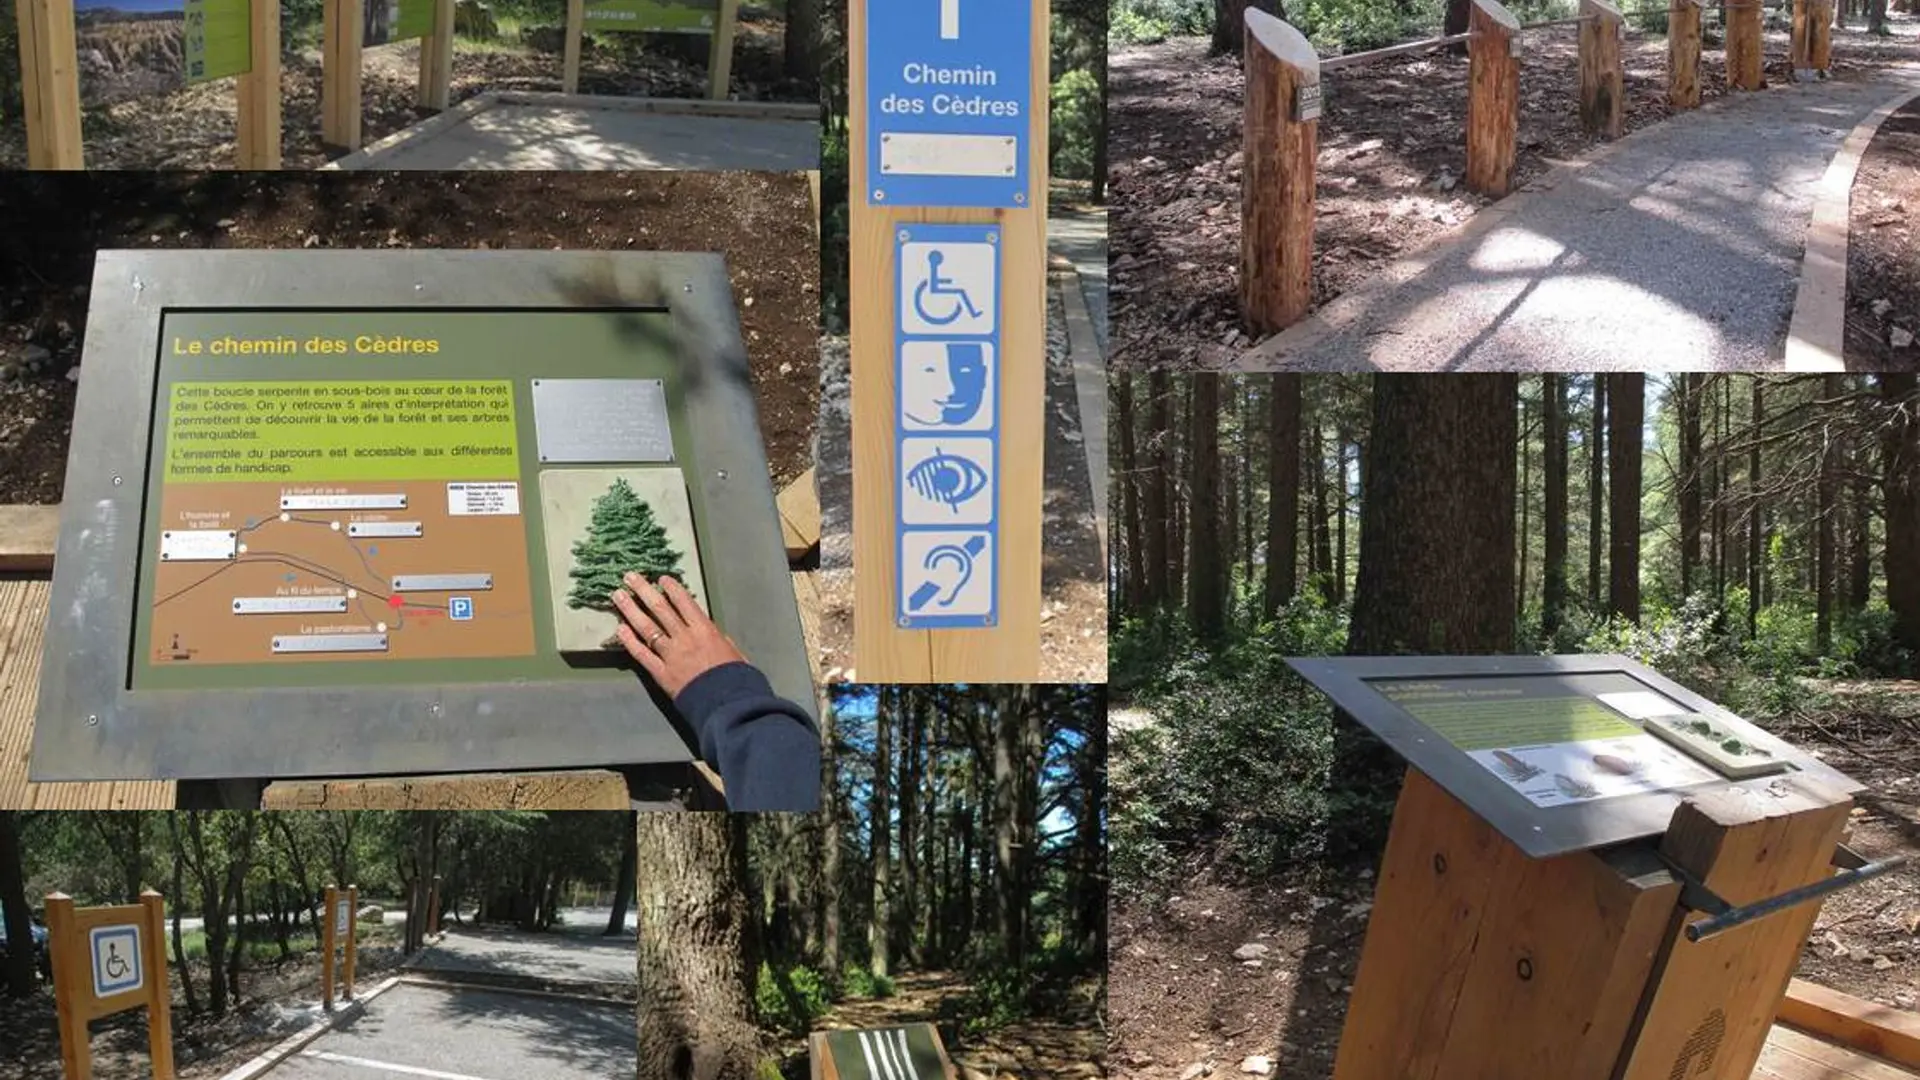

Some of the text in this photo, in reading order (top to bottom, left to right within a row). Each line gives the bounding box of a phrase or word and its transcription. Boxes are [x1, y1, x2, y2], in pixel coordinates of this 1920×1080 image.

[903, 63, 996, 86] Chemin
[880, 93, 1019, 116] des Cèdres
[174, 335, 439, 355] Le chemin des Cèdres
[177, 386, 210, 397] Cette
[213, 386, 255, 397] boucle
[258, 386, 310, 400] serpente
[314, 388, 329, 396] en
[332, 385, 391, 396] sous-bois
[394, 387, 409, 395] au
[447, 385, 463, 395] de
[465, 385, 477, 395] la
[480, 384, 507, 395] forêt
[175, 397, 509, 414] des Cèdres. On y retrouve 5 aires d'interprétation qui
[174, 412, 510, 427] permettent de découvrir la vie de la forêt et ses arbres
[173, 429, 260, 441] remarquables.
[171, 445, 513, 460] L'ensemble du parcours est accessible aux différentes
[170, 462, 292, 475] formes de handicap.
[455, 599, 467, 612] P
